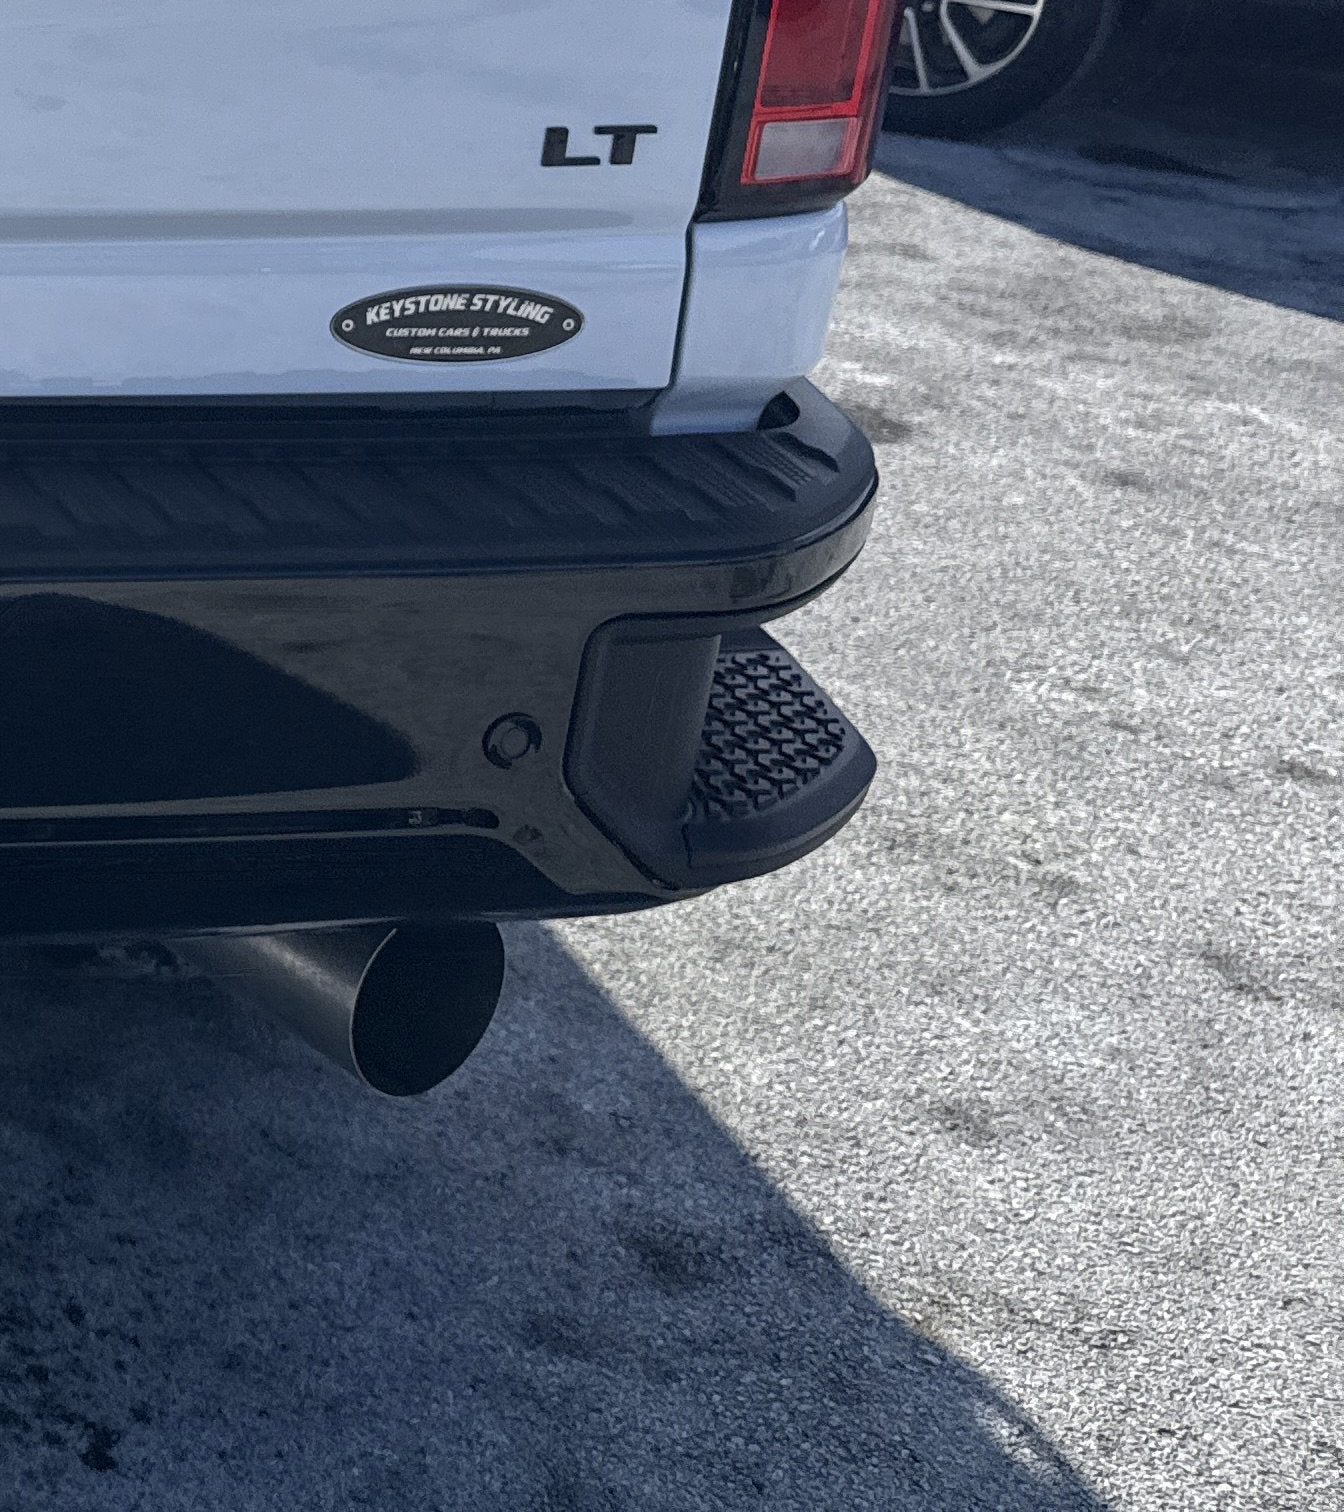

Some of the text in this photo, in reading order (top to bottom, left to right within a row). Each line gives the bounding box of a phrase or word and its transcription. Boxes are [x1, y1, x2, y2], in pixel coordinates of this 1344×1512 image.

[541, 125, 658, 166] LT
[366, 293, 554, 325] KEYSTONE STYLING
[385, 327, 436, 337] CUSTOM
[438, 327, 470, 337] CARS
[483, 327, 530, 337] TRUCKS
